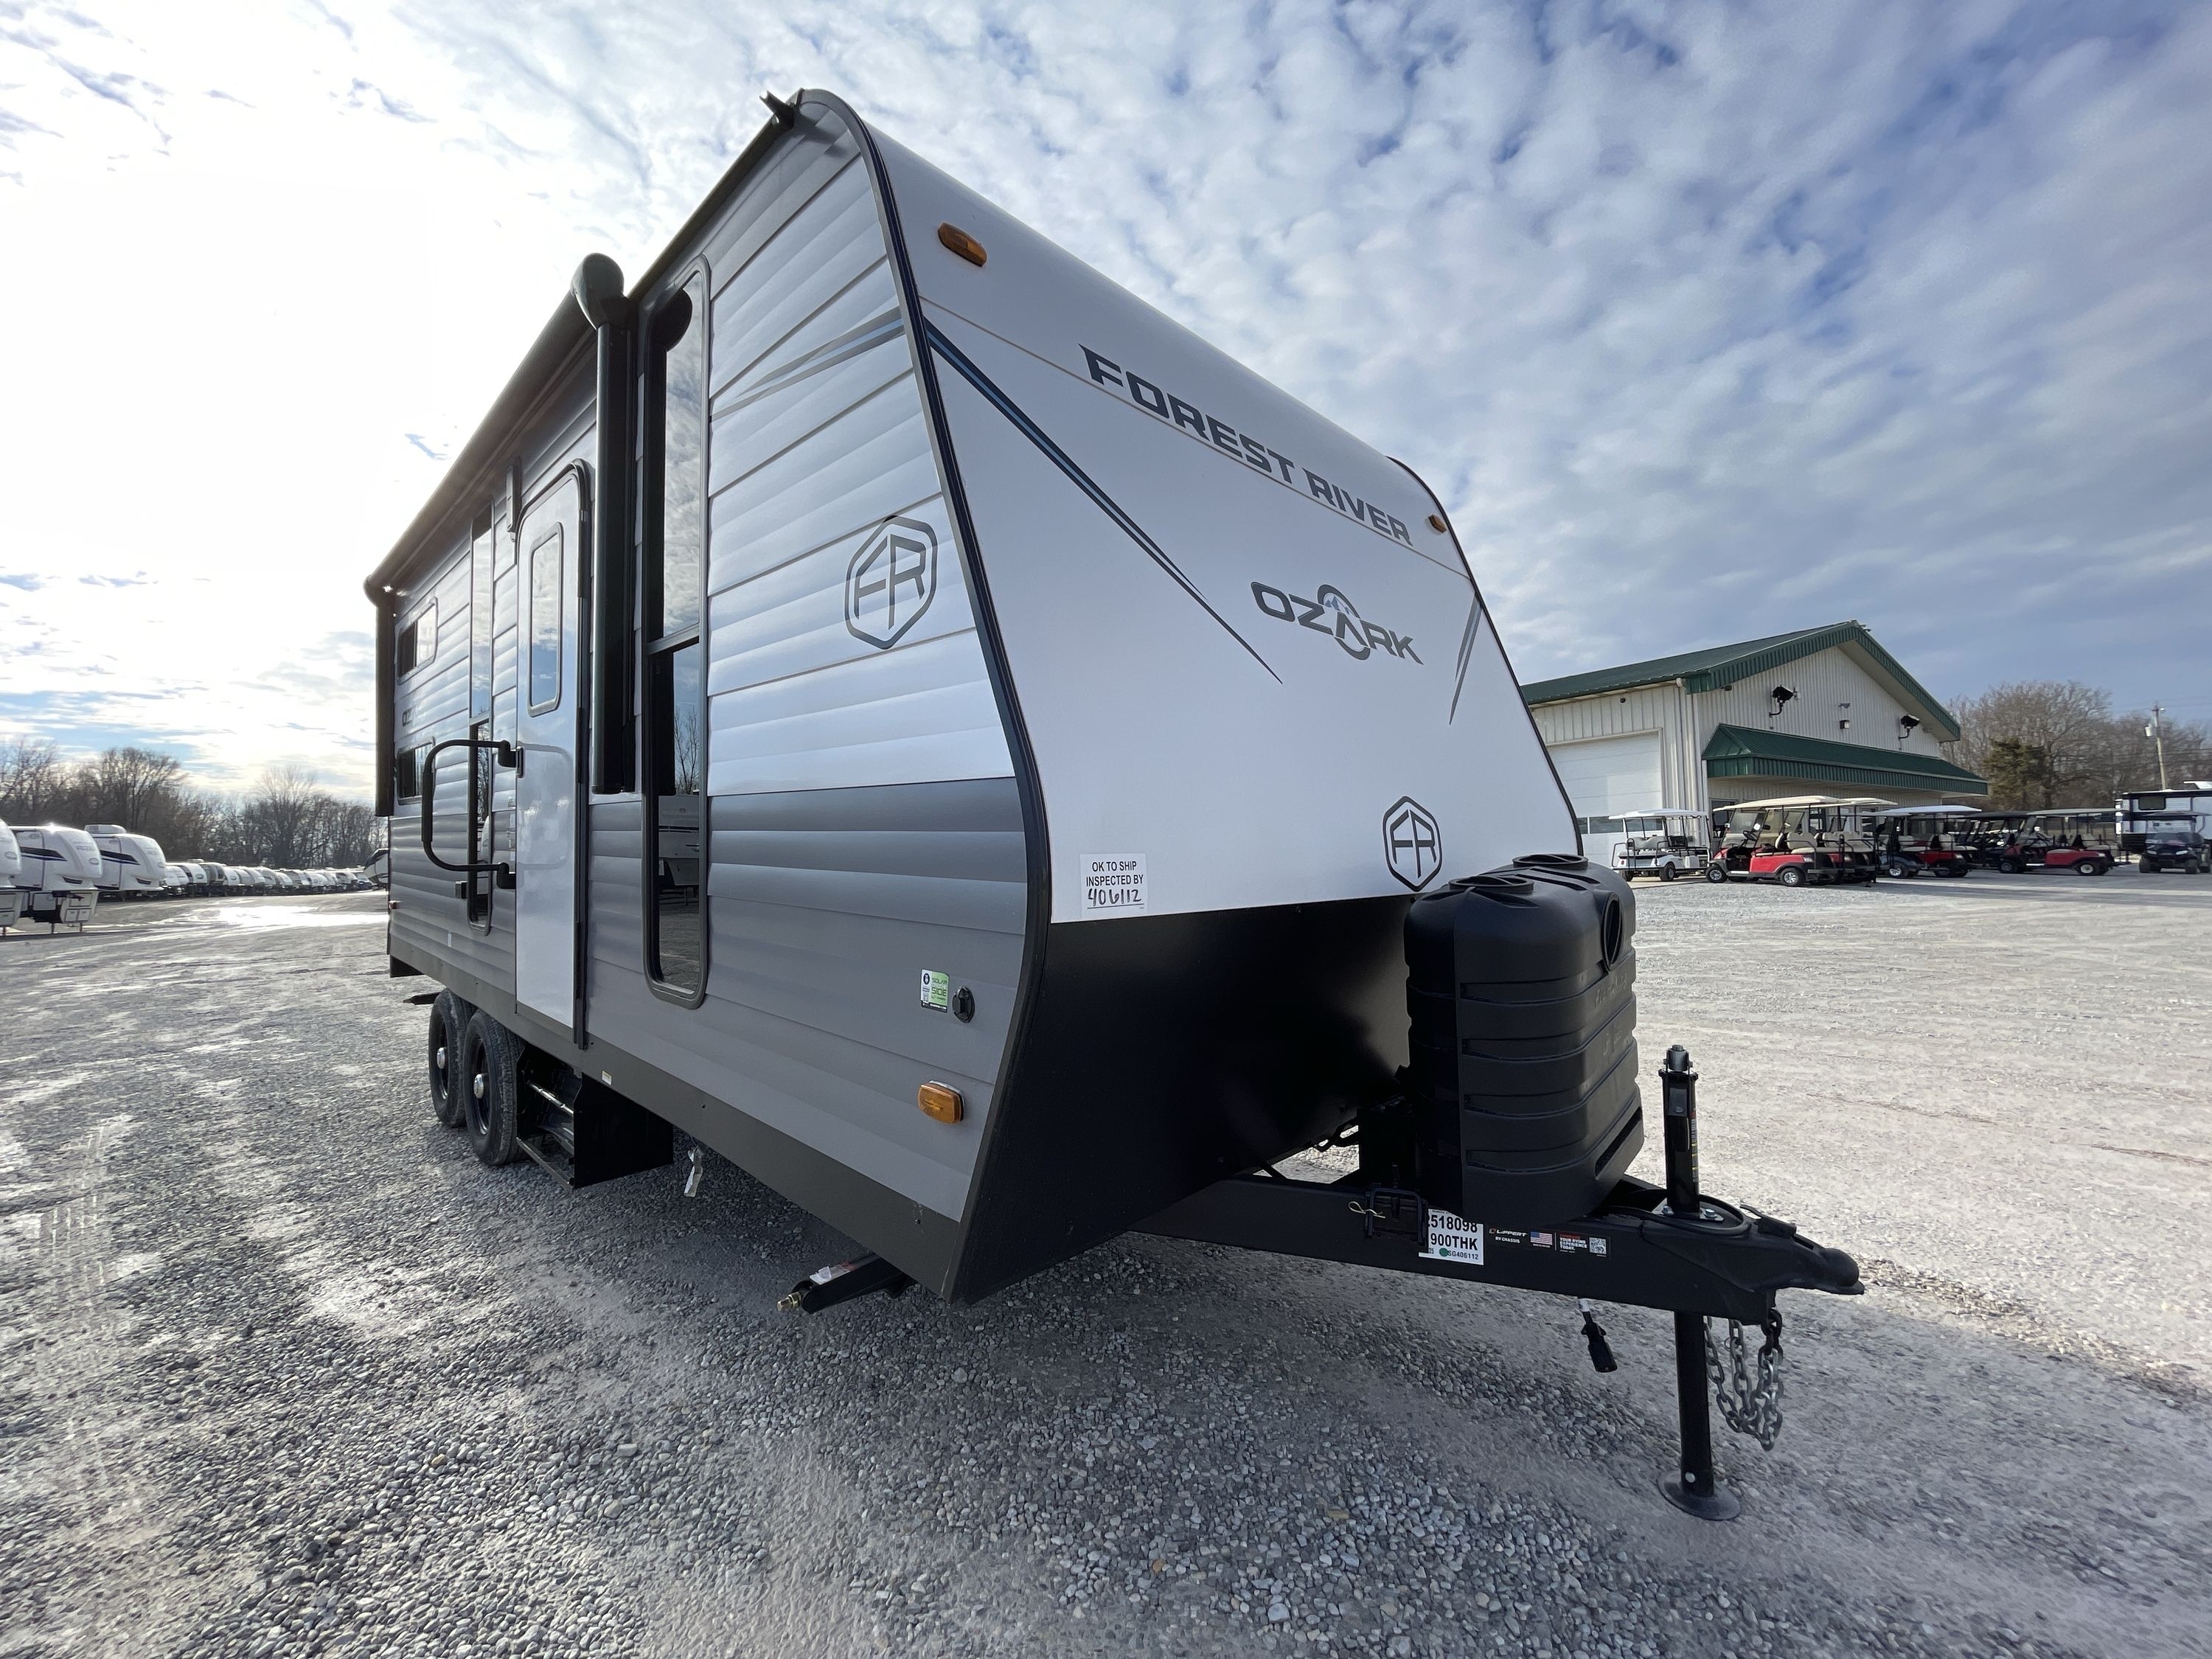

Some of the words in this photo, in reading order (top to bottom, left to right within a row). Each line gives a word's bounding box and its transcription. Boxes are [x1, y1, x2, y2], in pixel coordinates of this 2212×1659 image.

[1077, 343, 1295, 484] FOREST
[1301, 467, 1413, 547] RIVER
[1251, 581, 1424, 665] OZARK
[1092, 861, 1105, 872] OK
[1106, 861, 1117, 872] TO
[1119, 860, 1137, 871] SHIP
[1086, 874, 1131, 886] INSPECTED
[1133, 874, 1144, 884] BY
[1088, 888, 1142, 906] 406112
[931, 977, 947, 985] SOLAR
[931, 987, 947, 997] SIDE
[1428, 1214, 1478, 1234] 518098
[1430, 1233, 1478, 1251] 900THK
